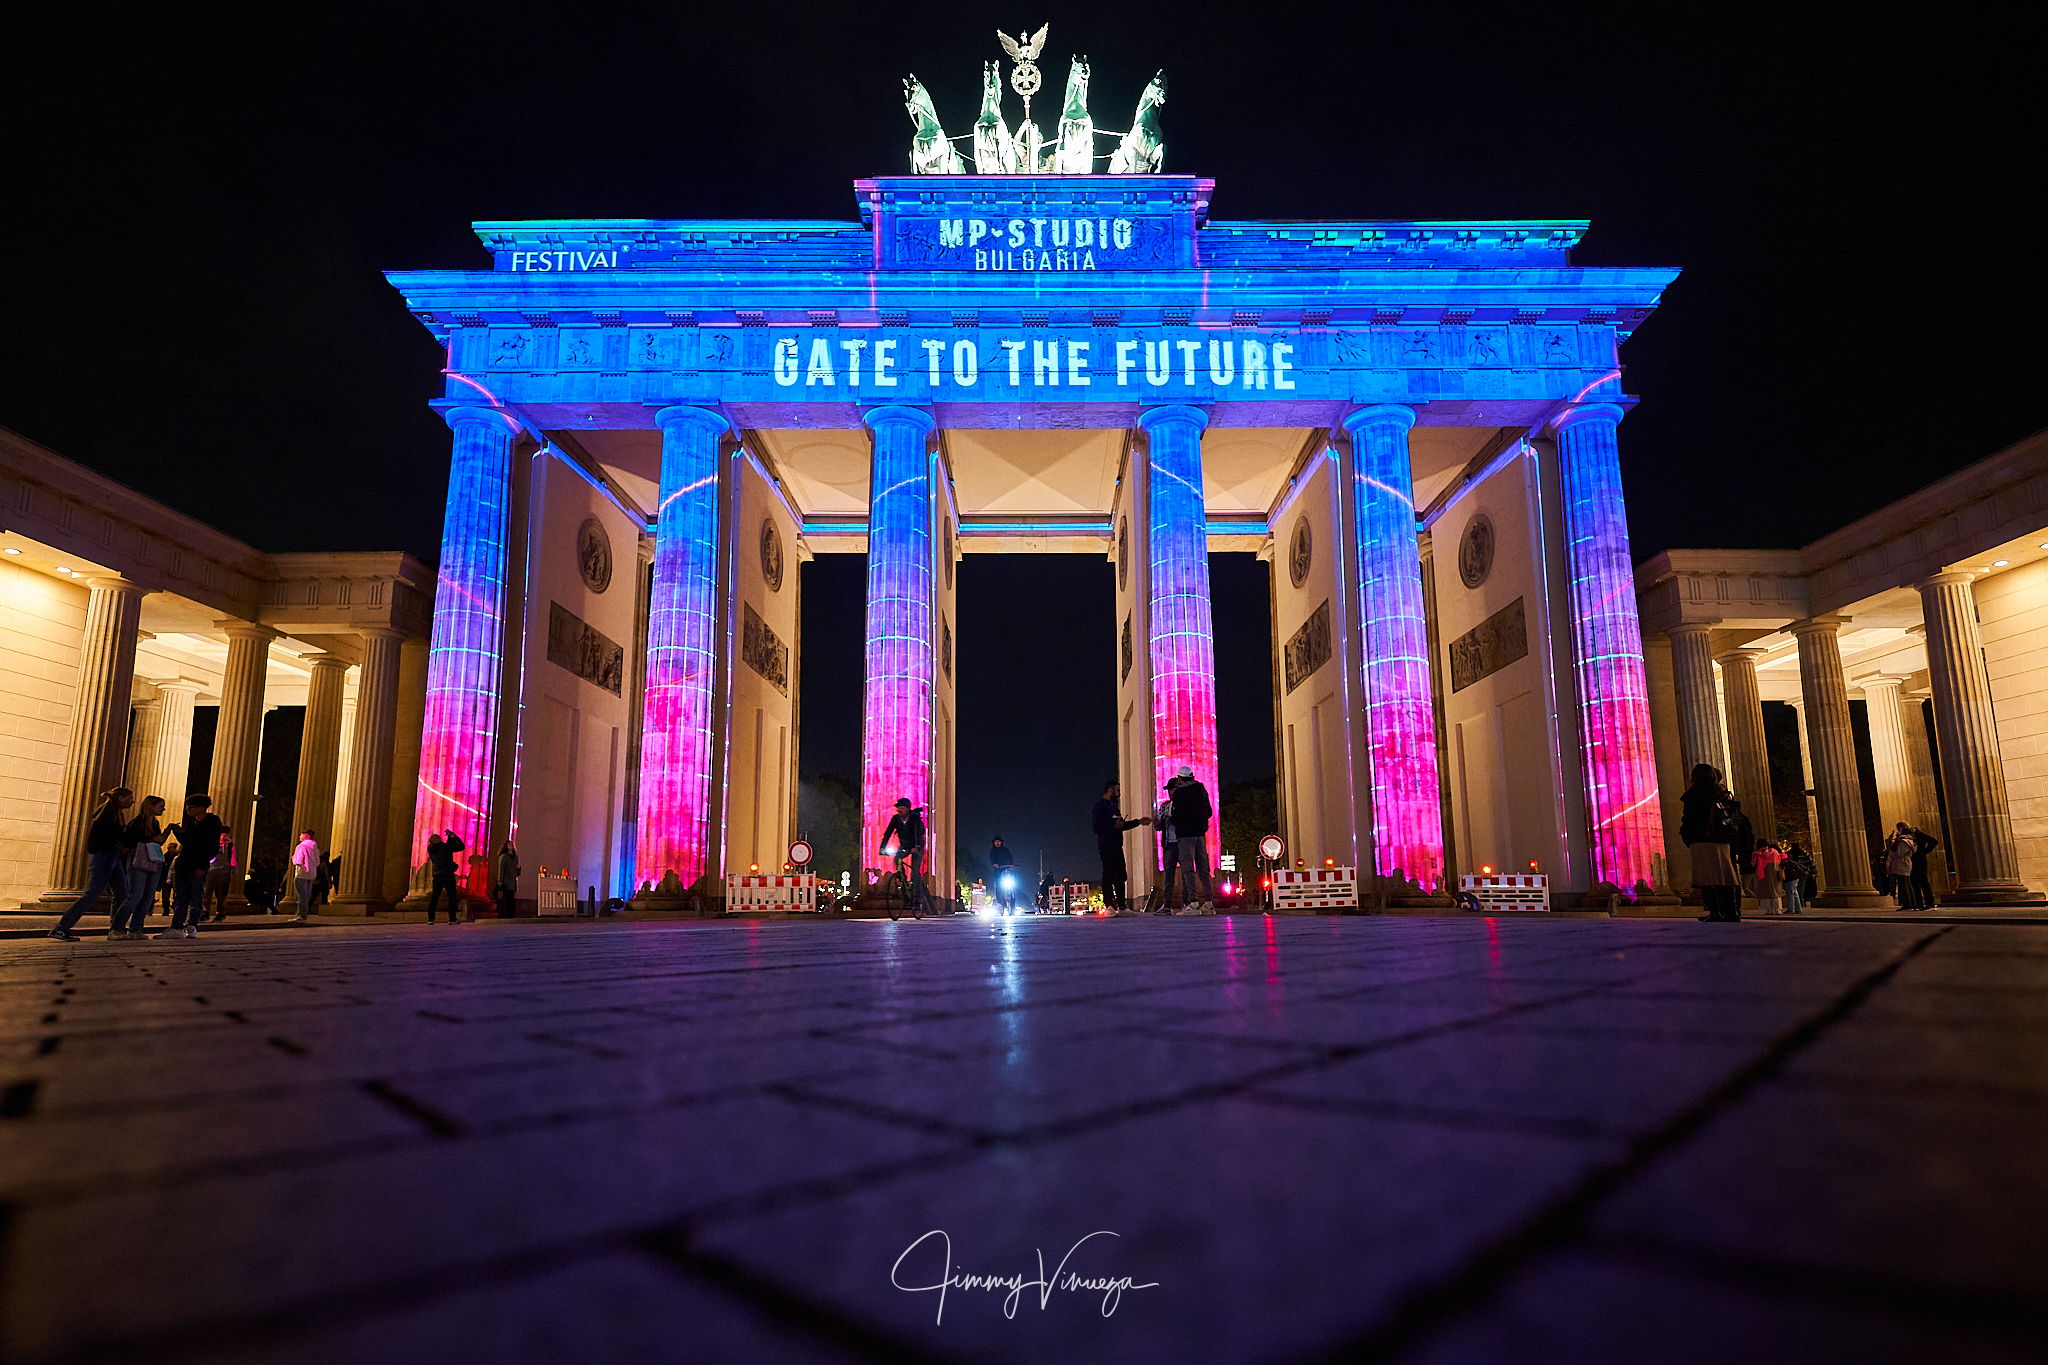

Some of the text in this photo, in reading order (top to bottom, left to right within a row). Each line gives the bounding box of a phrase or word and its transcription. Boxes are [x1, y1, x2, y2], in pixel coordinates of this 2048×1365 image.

[975, 248, 1096, 271] BULGARIA
[773, 338, 1296, 390] GATE TO THE FUTURE
